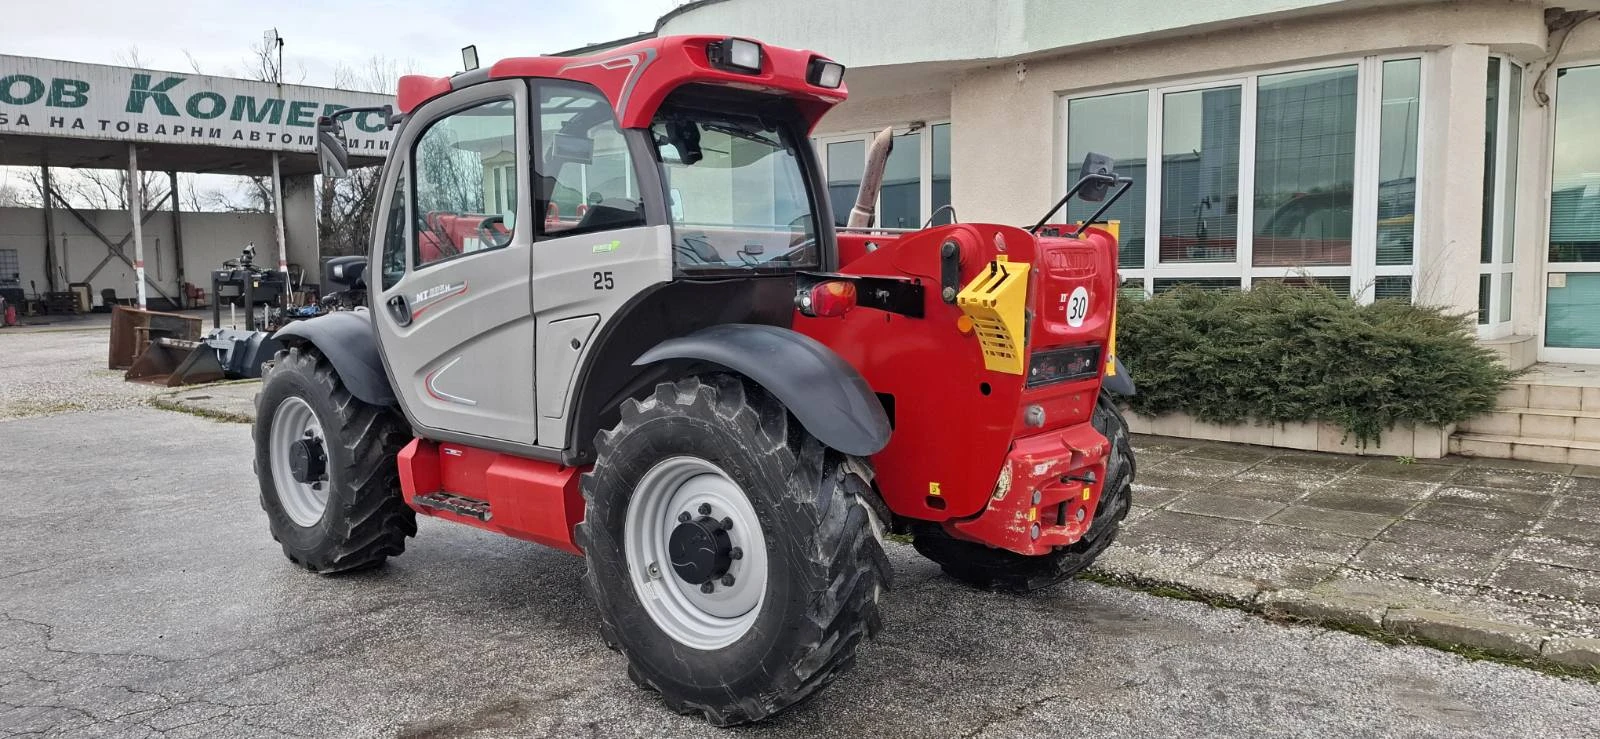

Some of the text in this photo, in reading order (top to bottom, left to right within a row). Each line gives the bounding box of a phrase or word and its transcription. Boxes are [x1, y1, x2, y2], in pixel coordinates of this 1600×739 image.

[50, 116, 85, 129] НА
[98, 119, 221, 138] ТОВАРНИ
[232, 130, 389, 150] АВТОМИЛИ
[593, 271, 614, 290] 25
[1070, 296, 1086, 319] 30
